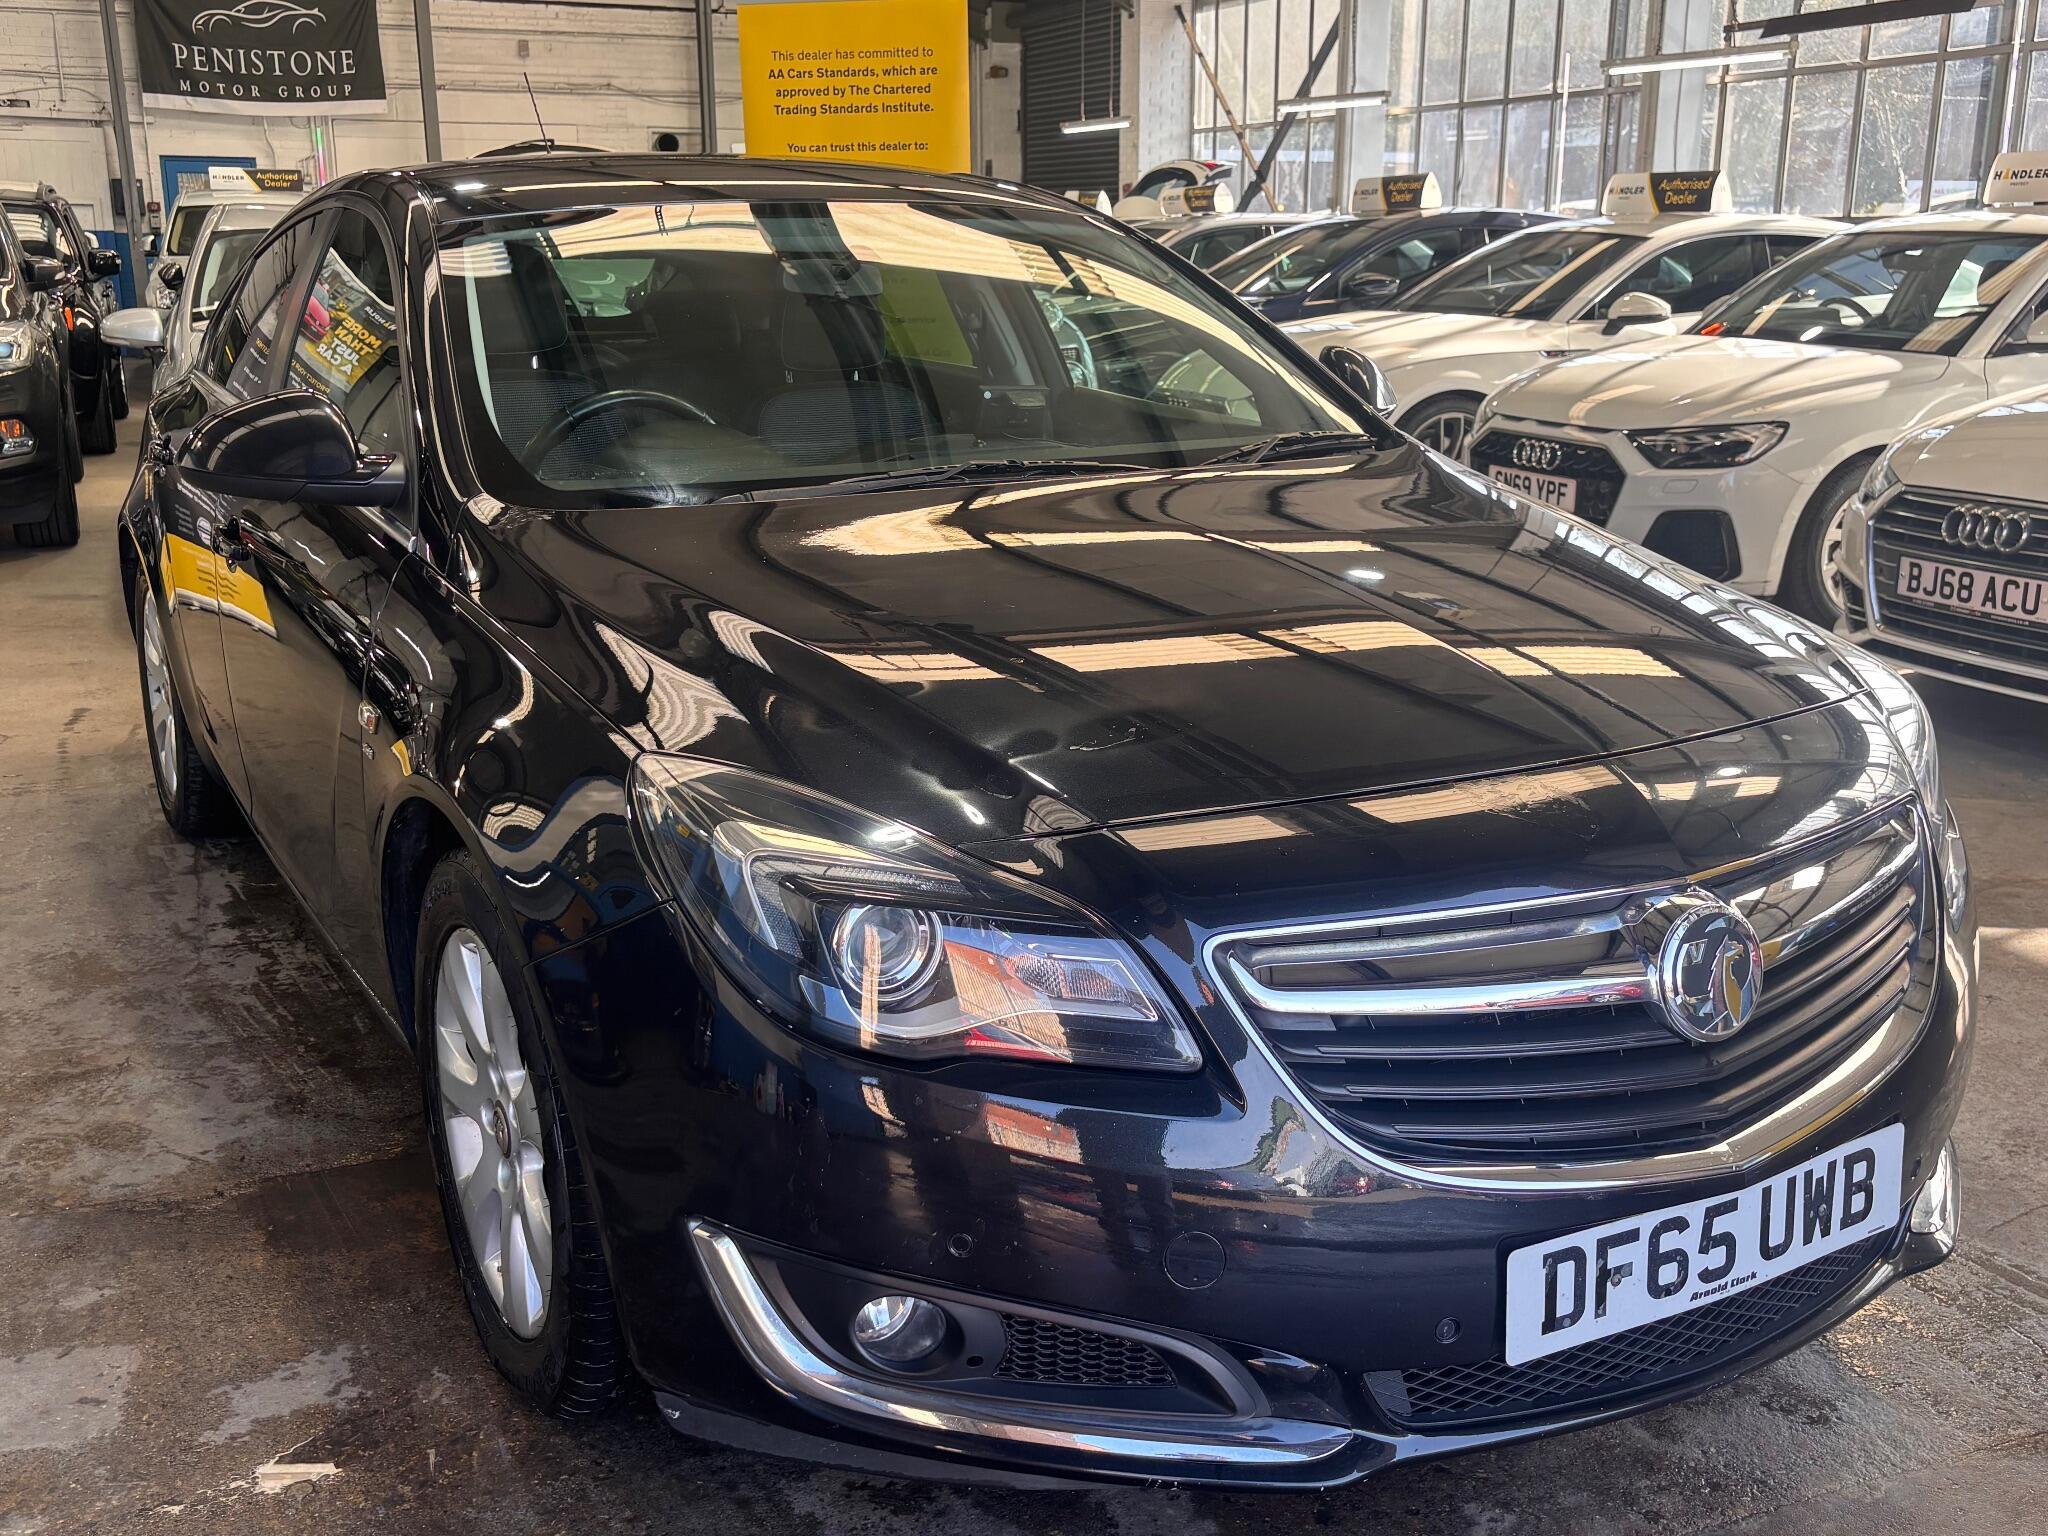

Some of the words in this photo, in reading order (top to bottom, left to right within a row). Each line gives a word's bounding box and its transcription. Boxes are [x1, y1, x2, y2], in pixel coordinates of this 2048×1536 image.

[172, 43, 356, 76] PENISTONE
[771, 50, 795, 62] This
[797, 49, 833, 61] dealer
[836, 48, 855, 60] has
[858, 46, 919, 60] committed
[923, 46, 934, 58] to
[768, 69, 785, 80] AA
[787, 68, 814, 79] Cars
[816, 66, 879, 79] Standards,
[882, 65, 917, 77] which
[919, 66, 938, 76] are
[180, 79, 261, 98] MOTOR
[278, 84, 352, 98] GROUP
[775, 85, 830, 99] approved
[832, 85, 846, 98] by
[848, 84, 870, 96] The
[873, 82, 932, 95] Chartered
[774, 104, 817, 117] Trading
[820, 102, 879, 115] Standards
[882, 101, 934, 113] Institute.
[787, 143, 807, 153] You
[809, 143, 827, 153] can
[830, 142, 855, 152] trust
[857, 141, 877, 152] this
[879, 140, 912, 151] dealer
[914, 140, 929, 151] to:
[256, 171, 298, 181] Authorised
[264, 180, 291, 188] Dealer
[1658, 175, 1713, 191] Authorised
[1664, 190, 1698, 205] Dealer
[1536, 477, 1568, 506] YPF
[1906, 561, 1975, 604] BJ68
[1980, 576, 2043, 616] ACU
[1541, 1196, 1739, 1337] DF65
[1758, 1147, 1877, 1262] UWB
[1689, 1280, 1729, 1302] Arnold
